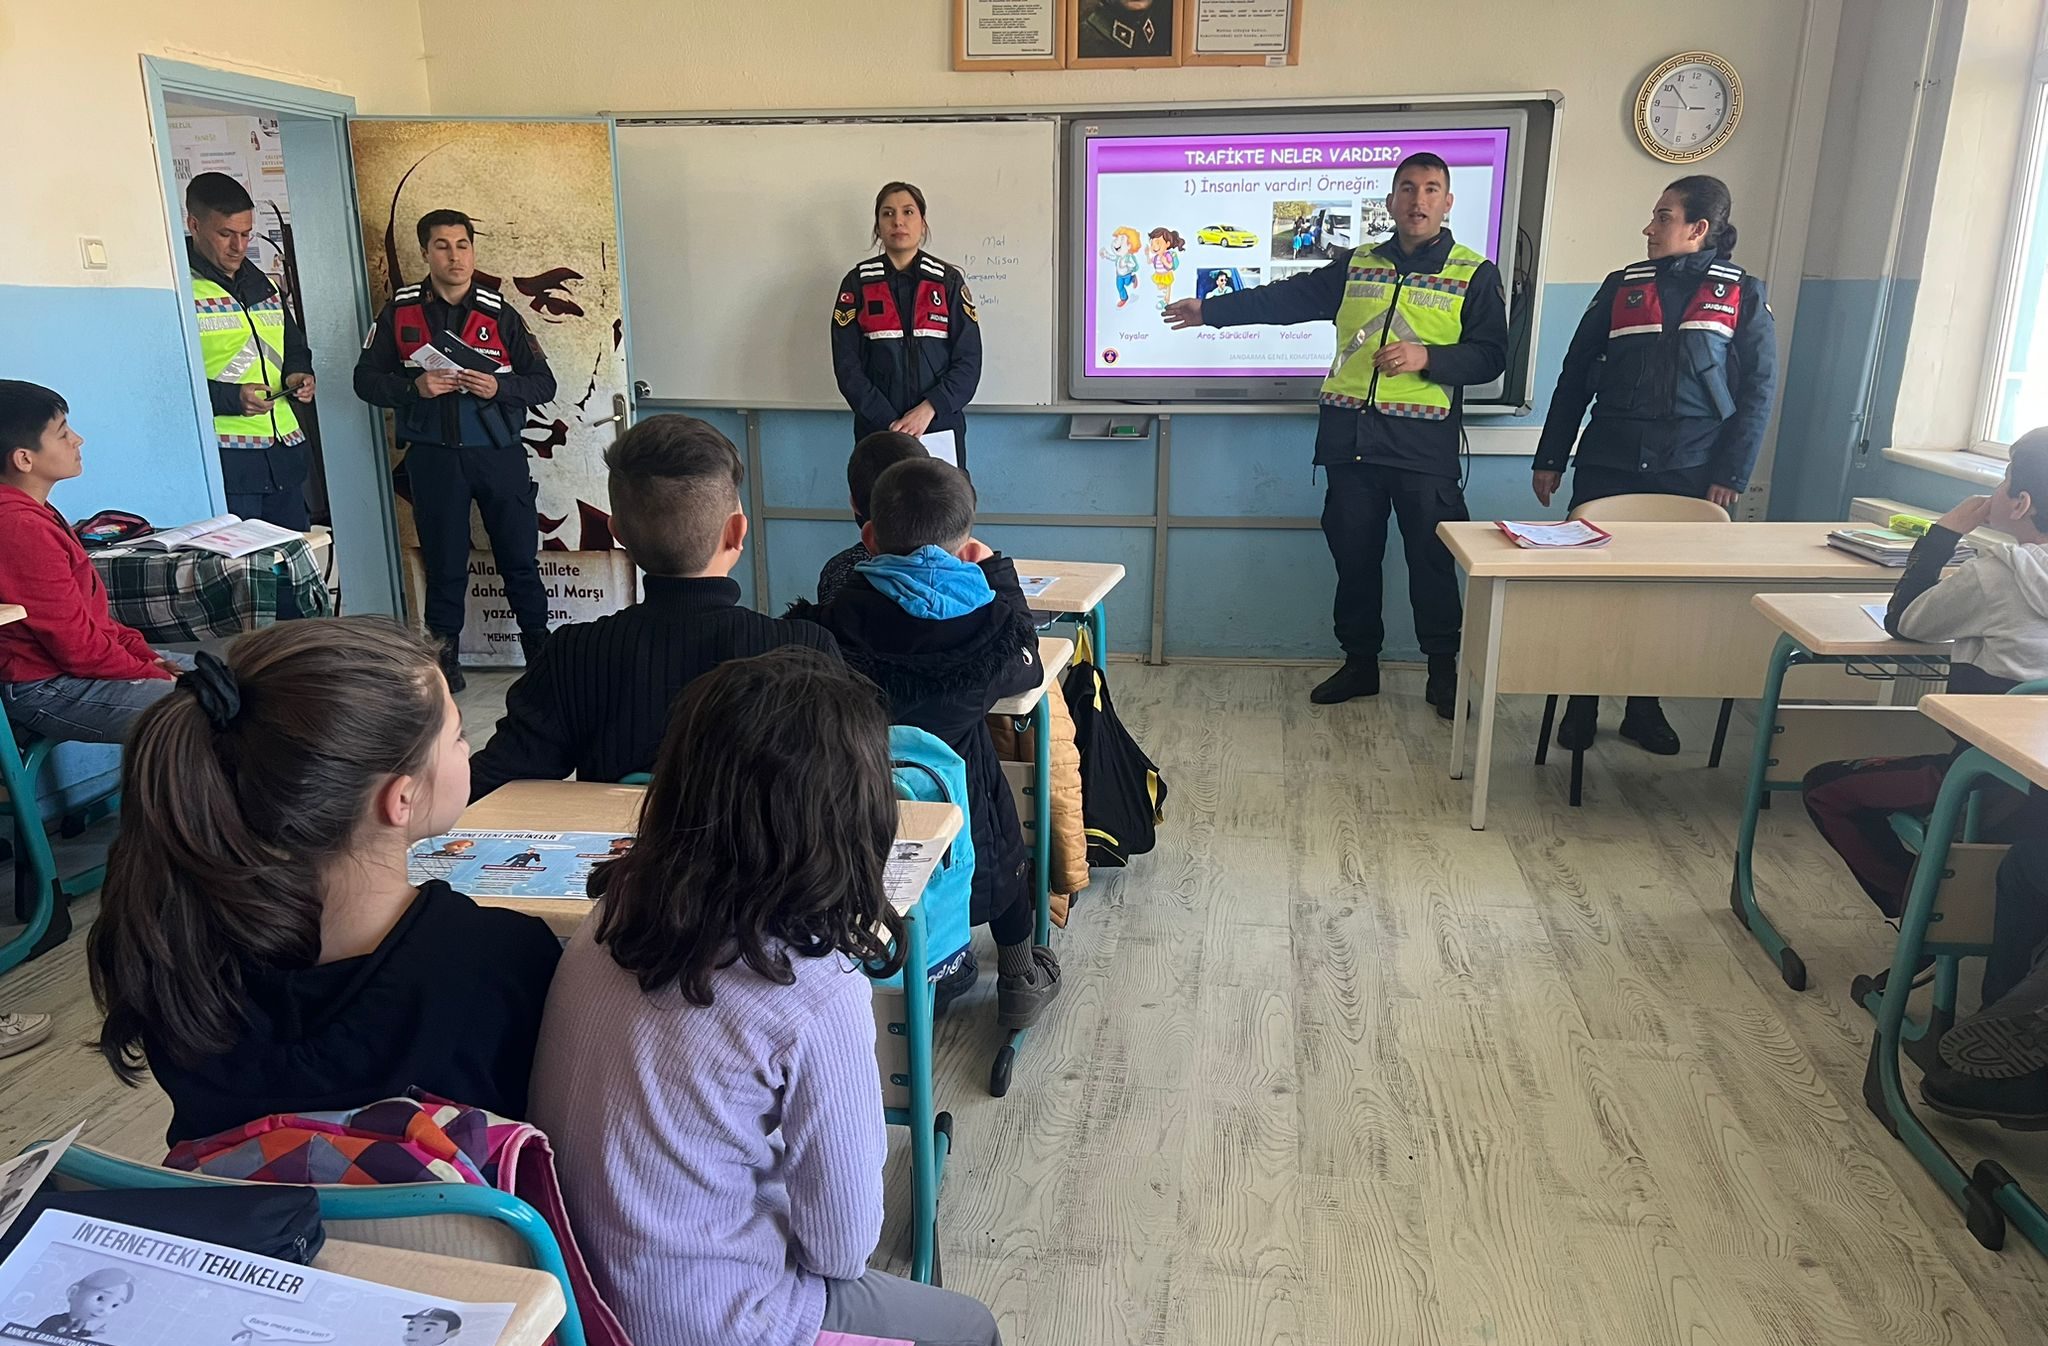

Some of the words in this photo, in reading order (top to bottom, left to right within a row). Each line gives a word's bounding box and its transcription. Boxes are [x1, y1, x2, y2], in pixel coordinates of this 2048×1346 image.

[1692, 72, 1702, 80] 12
[1663, 84, 1673, 92] 10
[1654, 99, 1661, 107] 9
[1714, 108, 1721, 116] 3
[1662, 128, 1669, 136] 7
[1705, 123, 1712, 131] 4
[1675, 135, 1681, 143] 6
[1184, 147, 1265, 165] TRAFİKTE
[1271, 148, 1322, 164] NELER
[1329, 146, 1402, 163] VARDIR?
[1184, 179, 1196, 196] 1)
[1201, 176, 1260, 193] İnsanlar
[1264, 177, 1312, 192] vardır!
[1317, 174, 1379, 195] Örneğin:
[986, 255, 1020, 265] Nisan
[1119, 331, 1149, 342] Yayalar
[1196, 331, 1216, 341] Araç
[1219, 330, 1260, 340] Sürücüleri
[1279, 330, 1313, 340] Yolcular
[1289, 351, 1333, 361] KOMUTANLIĞ
[564, 584, 604, 603] Marşı
[72, 1220, 202, 1269] İNTERNETTEKİ
[198, 1252, 305, 1295] TEHLİKELER
